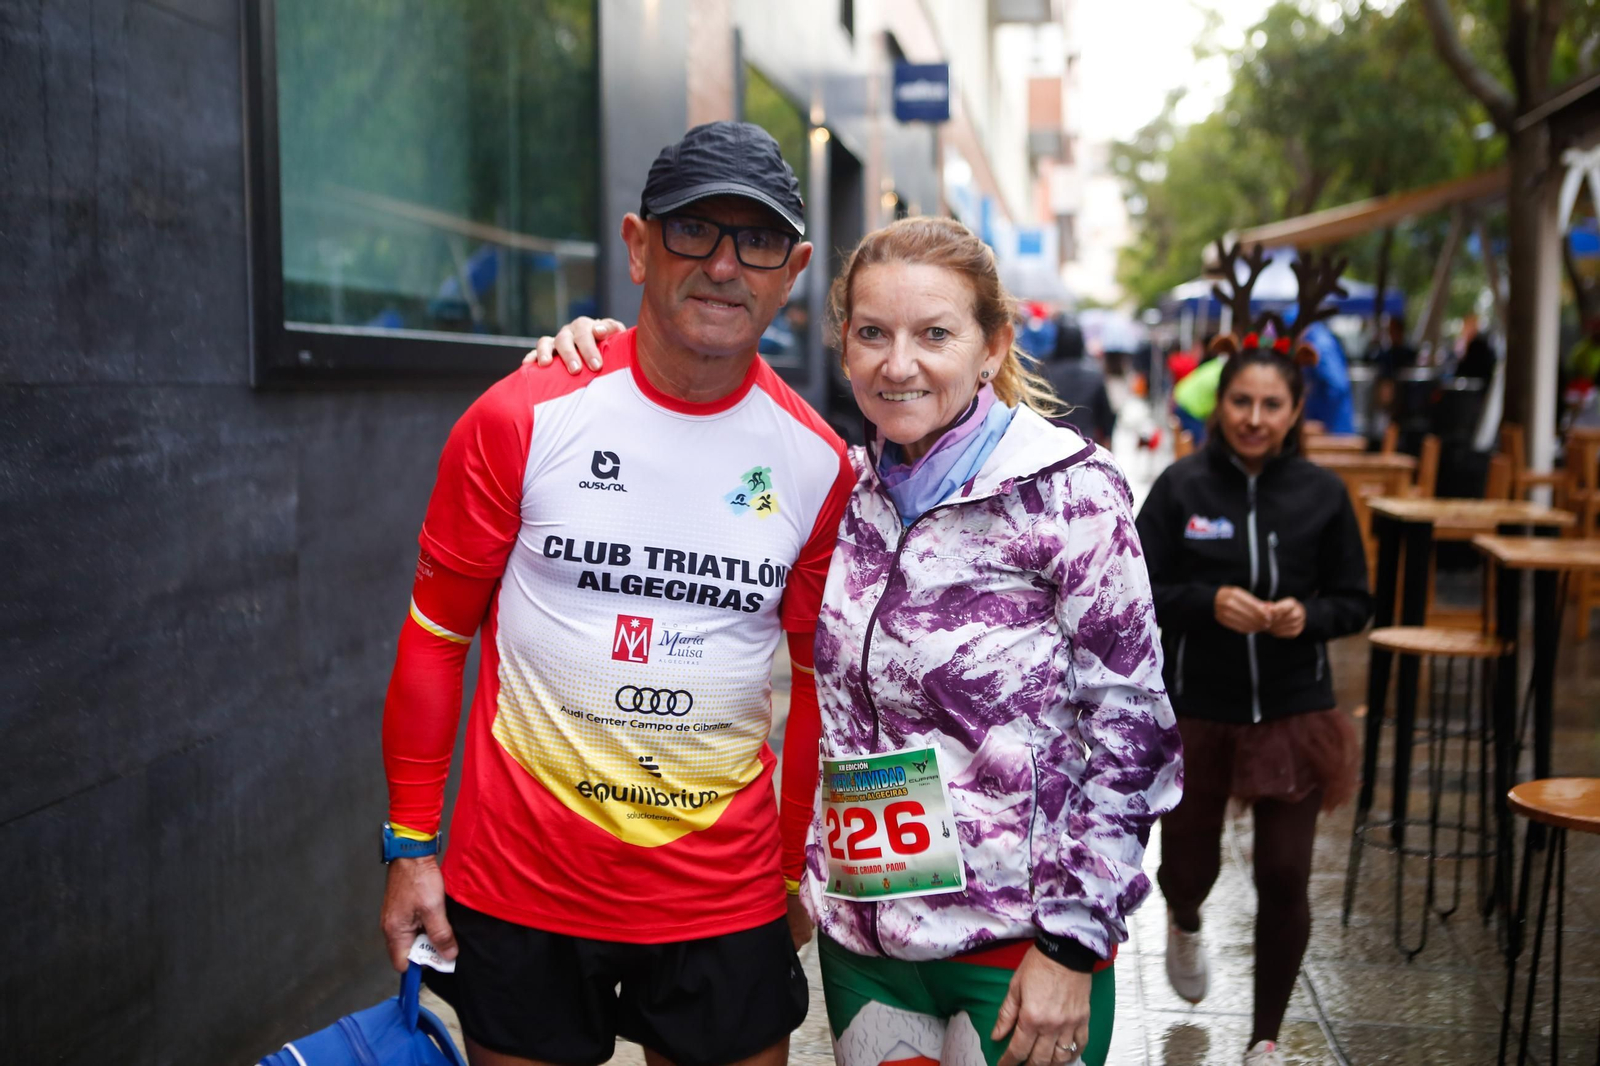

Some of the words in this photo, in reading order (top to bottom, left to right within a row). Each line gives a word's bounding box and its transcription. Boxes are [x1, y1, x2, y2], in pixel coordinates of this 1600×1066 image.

[579, 480, 628, 492] austral
[543, 535, 631, 567] CLUB
[643, 546, 786, 588] TRIATLÓN
[577, 570, 764, 613] ALGECIRAS
[658, 630, 704, 646] María
[560, 705, 584, 719] Audi
[586, 713, 627, 727] Center
[630, 719, 673, 732] Campo
[676, 723, 690, 732] de
[693, 722, 732, 732] Gibraltar
[846, 762, 869, 771] EDICIÓN
[855, 766, 906, 792] NAVIDAD
[575, 781, 718, 809] equilibrium
[867, 788, 908, 800] ALGECIRAS
[626, 811, 680, 822] solucioterapia
[826, 801, 930, 860] 226
[886, 862, 907, 872] PAQUI
